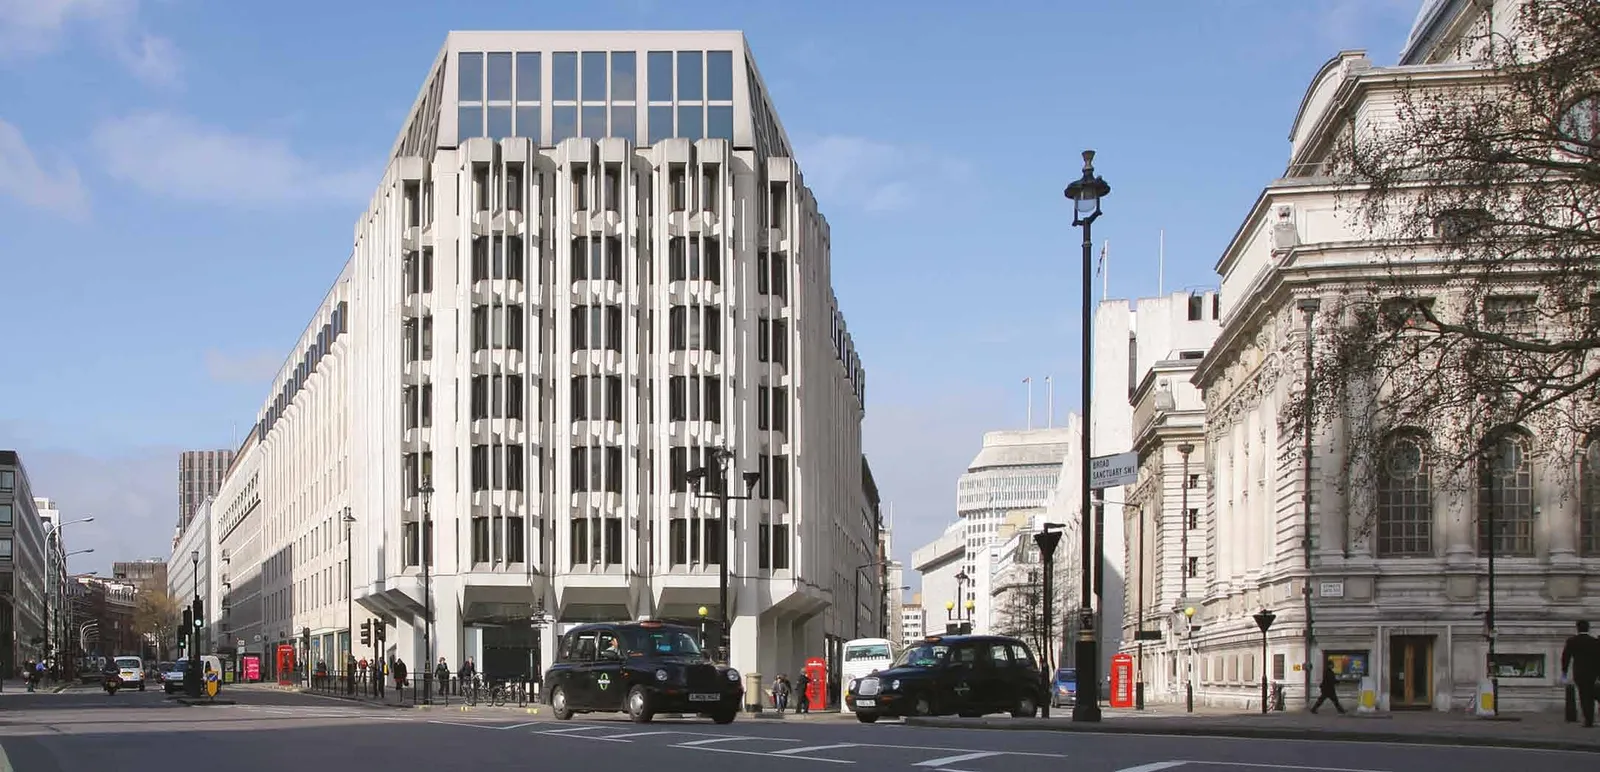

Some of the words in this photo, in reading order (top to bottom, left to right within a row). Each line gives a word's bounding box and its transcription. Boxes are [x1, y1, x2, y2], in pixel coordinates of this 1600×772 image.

[1092, 459, 1109, 469] BROAD
[1092, 467, 1122, 480] SANCTUARY
[1123, 465, 1135, 475] SW1
